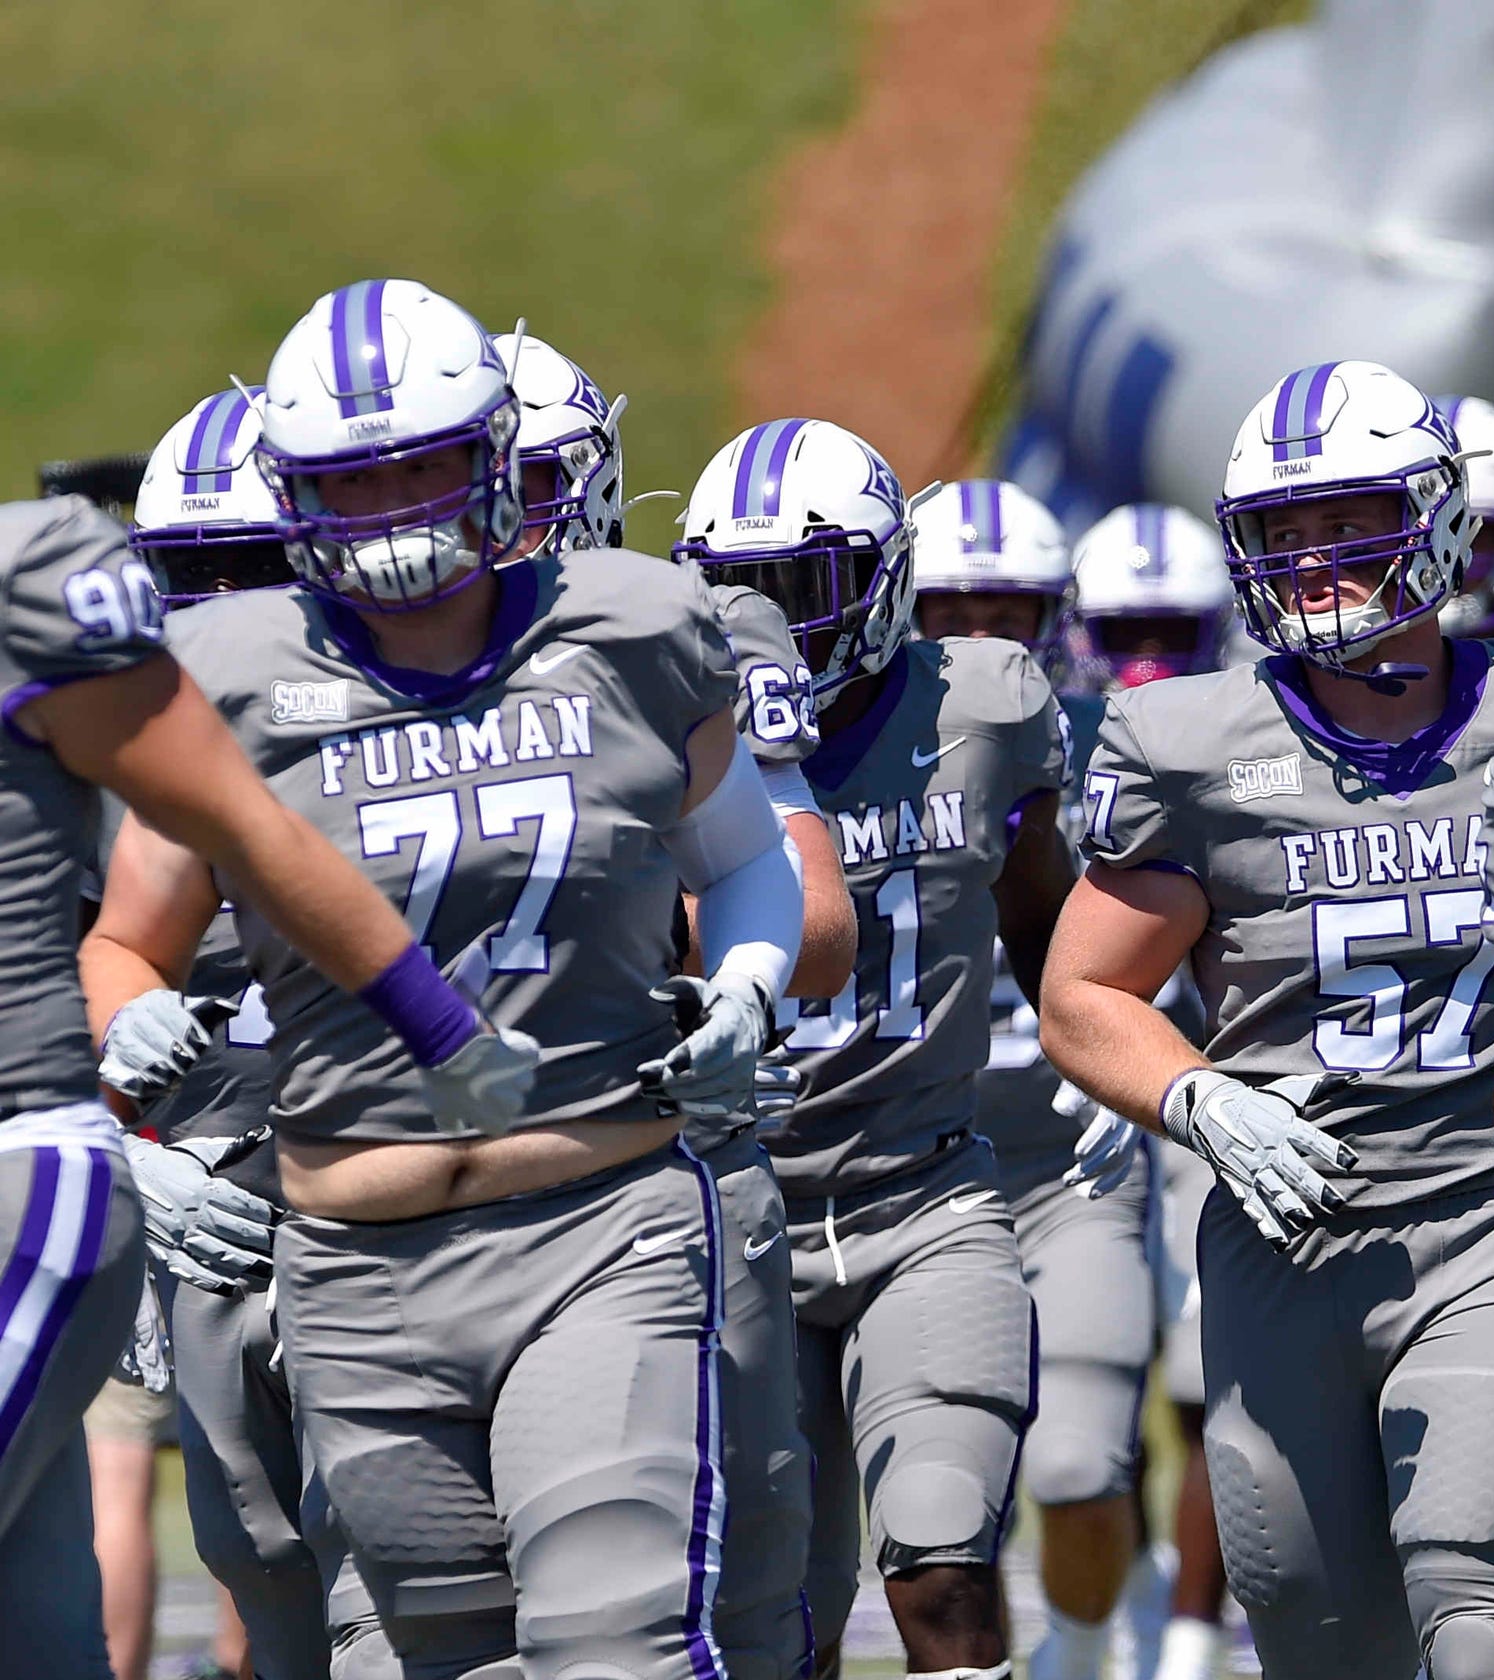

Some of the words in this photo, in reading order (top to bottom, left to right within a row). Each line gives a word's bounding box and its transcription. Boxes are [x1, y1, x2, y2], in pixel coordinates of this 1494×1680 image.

[180, 497, 220, 512] FURMAN
[1273, 461, 1311, 480] FURMAN
[735, 519, 774, 532] FURMAN
[64, 560, 162, 655] 90
[317, 694, 593, 797] FURMAN
[836, 790, 967, 867] MAN
[1084, 769, 1120, 852] 7
[356, 771, 578, 974] 77
